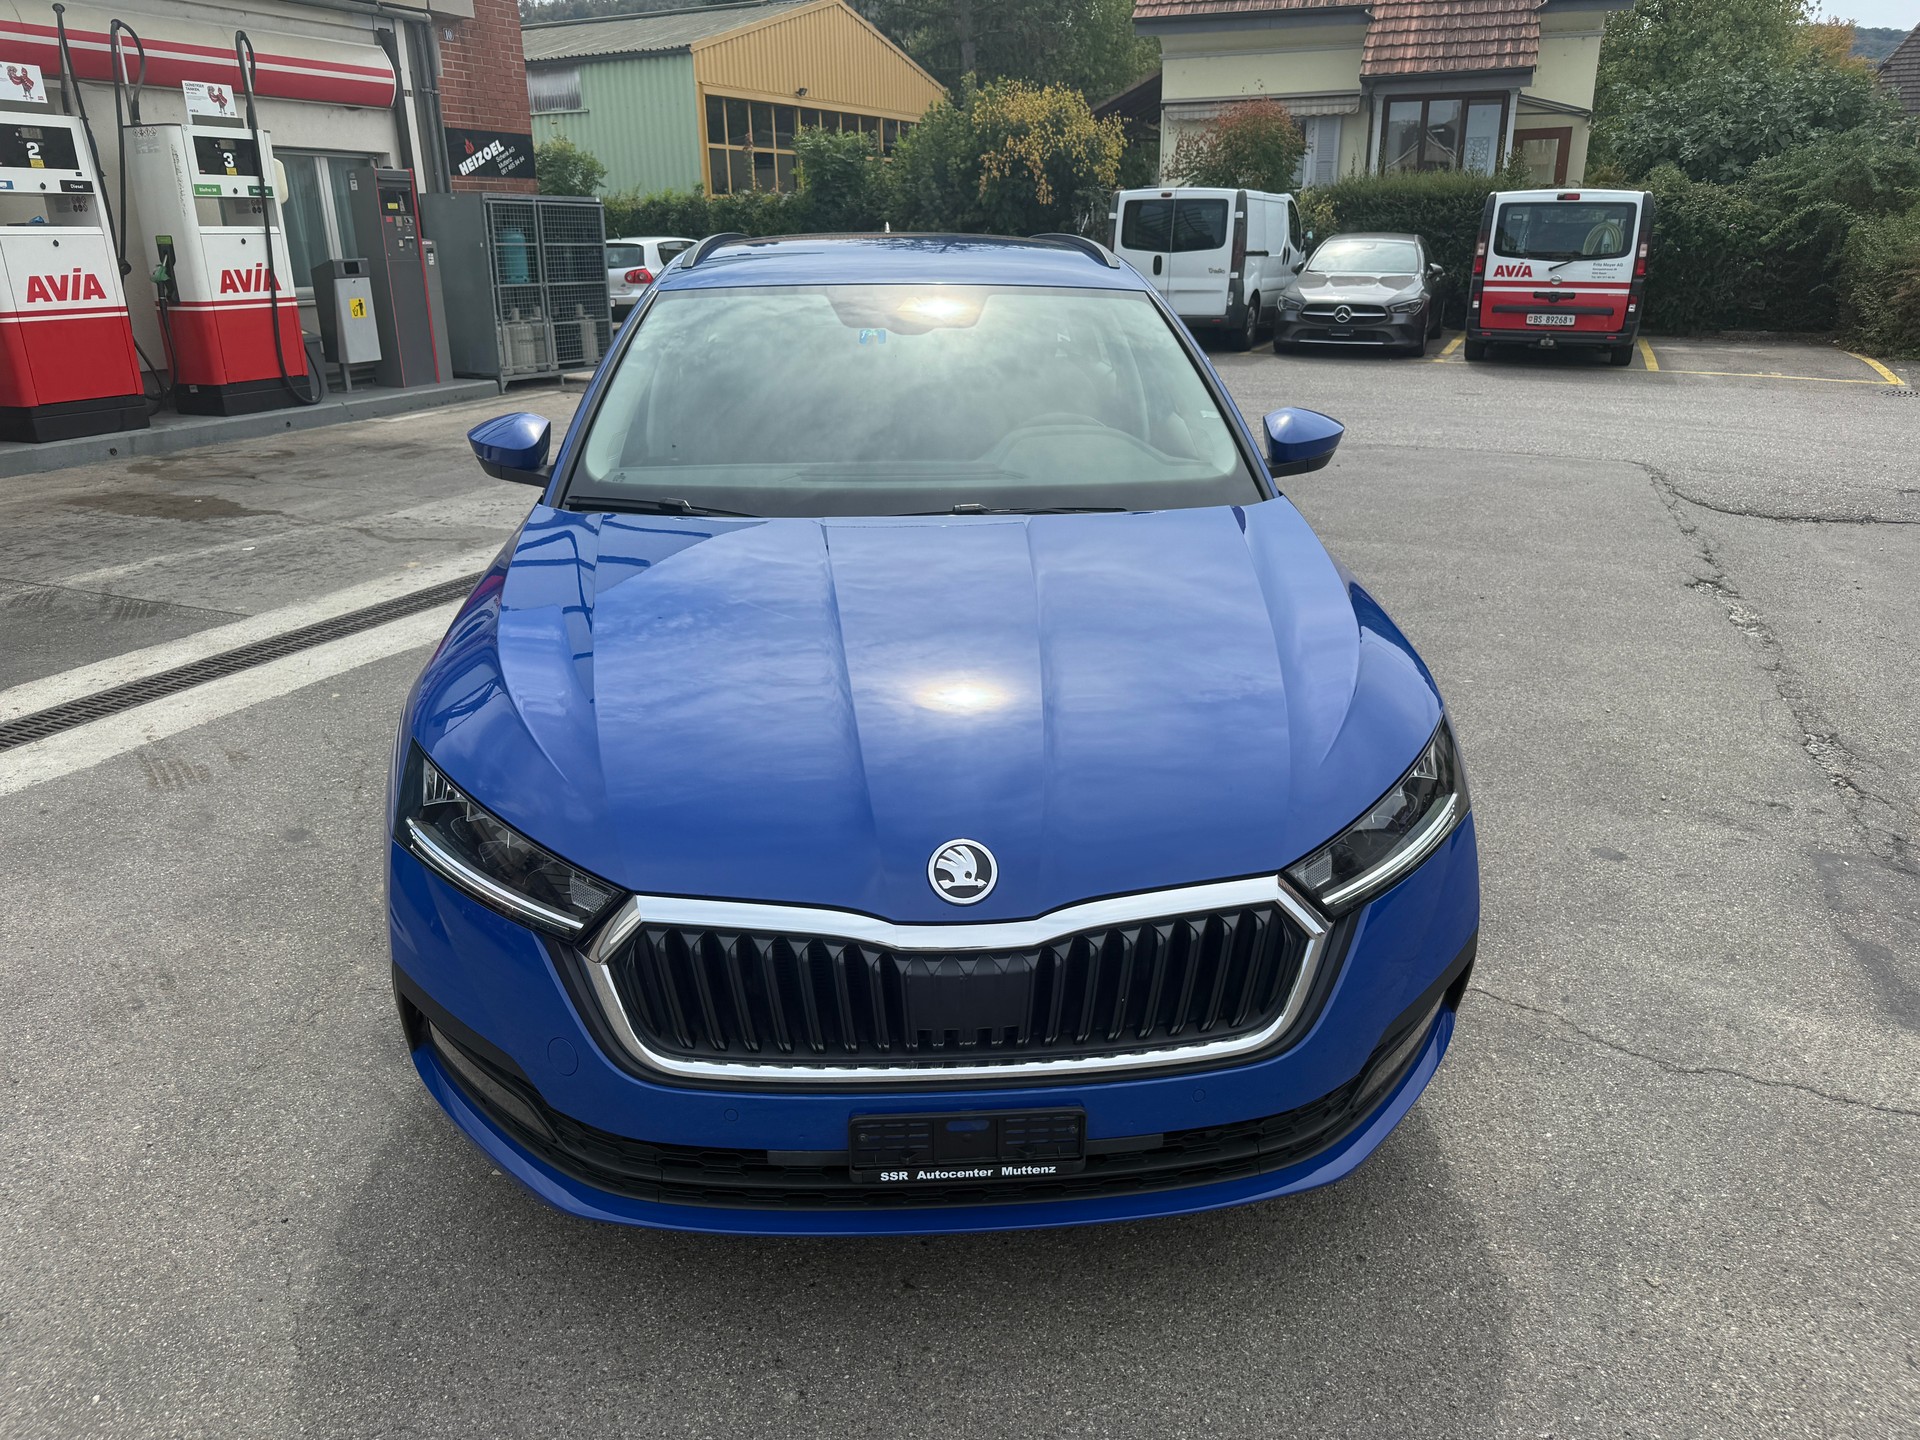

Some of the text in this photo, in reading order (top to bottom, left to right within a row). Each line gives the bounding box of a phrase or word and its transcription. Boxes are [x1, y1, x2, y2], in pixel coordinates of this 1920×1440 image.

[26, 142, 42, 160] 2
[223, 152, 235, 168] 3
[458, 140, 504, 176] HEIZOEL
[220, 263, 282, 294] AVIA
[1493, 262, 1533, 278] AVIA
[26, 268, 107, 303] AVIA
[880, 1164, 1057, 1181] SSR Autocenter Muttenz
